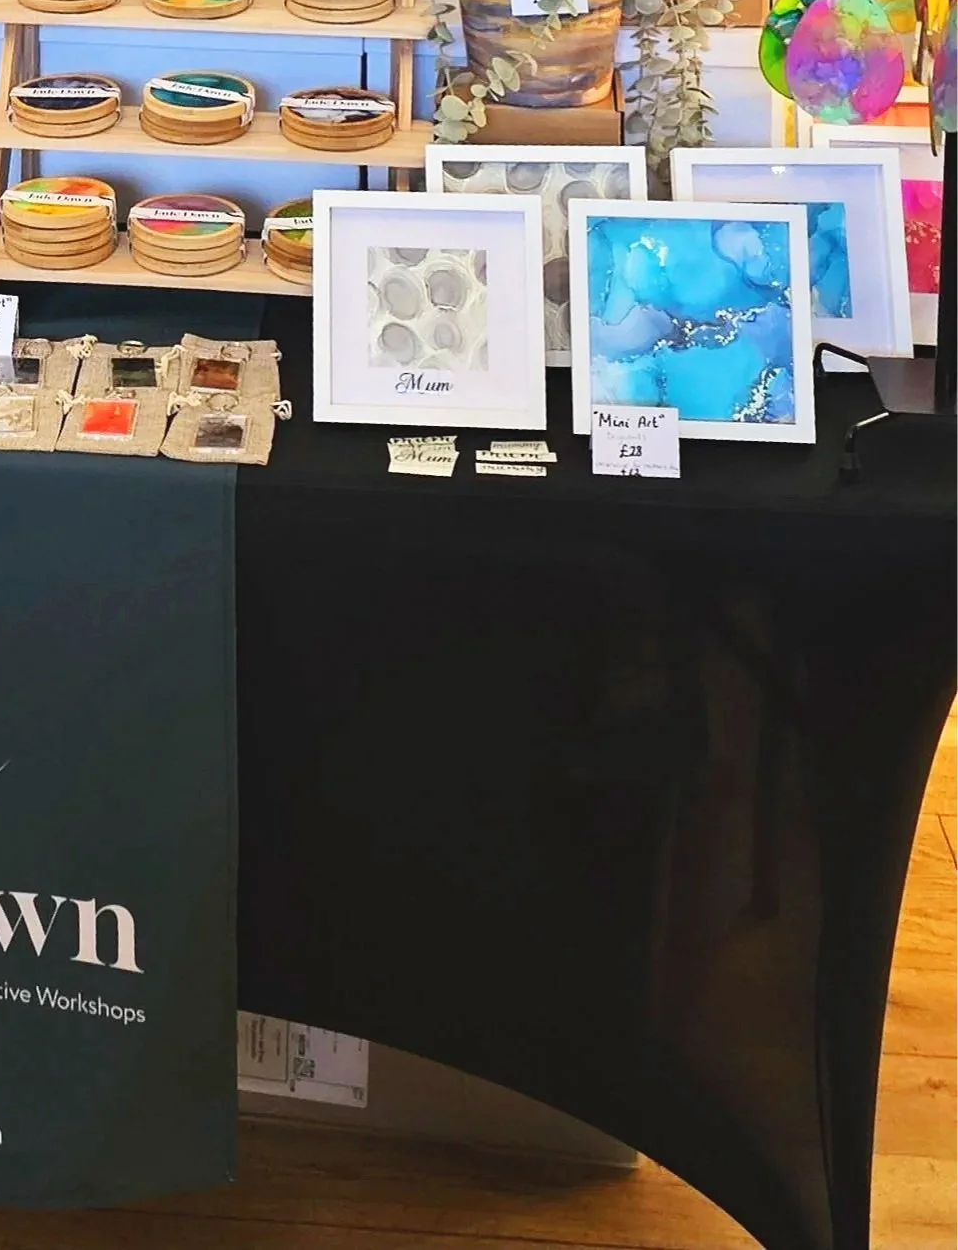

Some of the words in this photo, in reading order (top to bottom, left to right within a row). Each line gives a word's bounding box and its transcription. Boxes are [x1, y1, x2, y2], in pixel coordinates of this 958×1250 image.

[395, 372, 453, 394] Mum
[619, 444, 643, 459] £28
[35, 984, 147, 1026] Workshops
